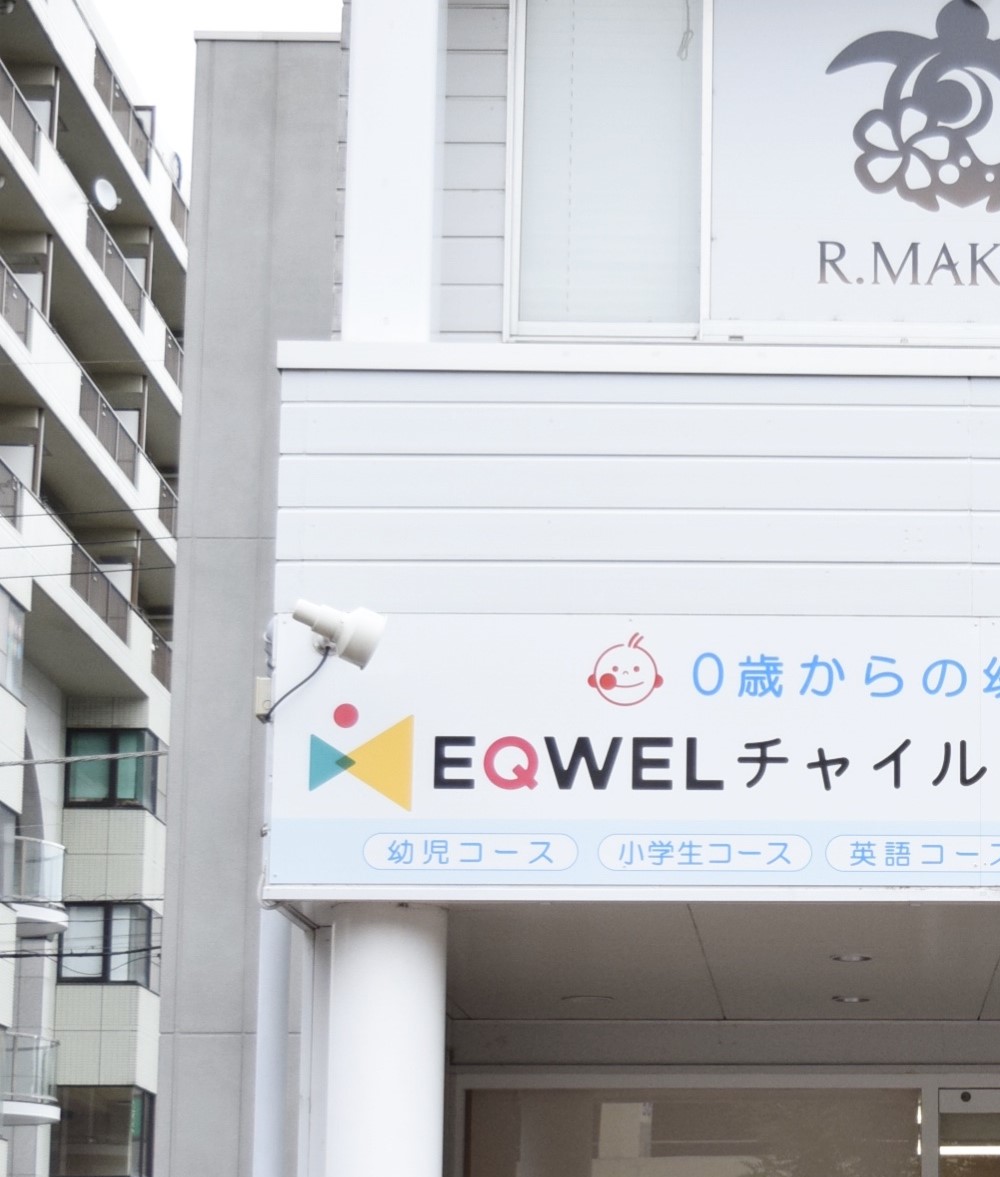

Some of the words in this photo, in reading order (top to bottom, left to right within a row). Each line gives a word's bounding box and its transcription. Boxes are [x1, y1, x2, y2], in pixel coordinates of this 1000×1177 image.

[434, 735, 724, 791] EQWEL
[387, 839, 554, 865] 幼児コース
[618, 839, 791, 866] 小学生コース
